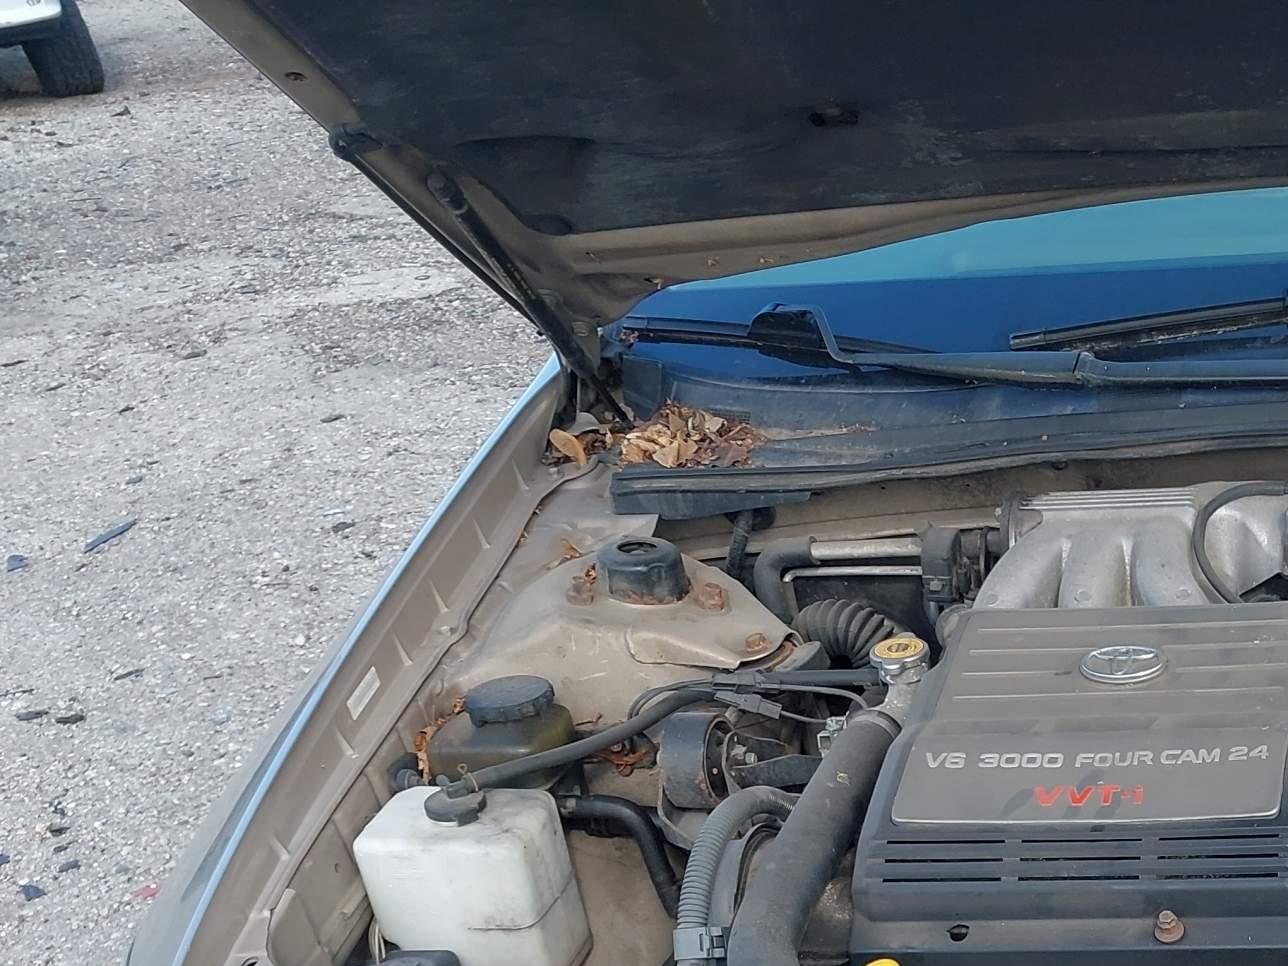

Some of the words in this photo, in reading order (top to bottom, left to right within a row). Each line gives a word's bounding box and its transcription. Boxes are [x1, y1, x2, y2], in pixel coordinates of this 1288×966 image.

[925, 751, 967, 769] V6
[977, 751, 1064, 769] 3000
[1074, 750, 1154, 768] FOUR
[1159, 748, 1221, 765] CAM
[1228, 744, 1270, 762] 24
[1034, 784, 1145, 807] VVT-i
